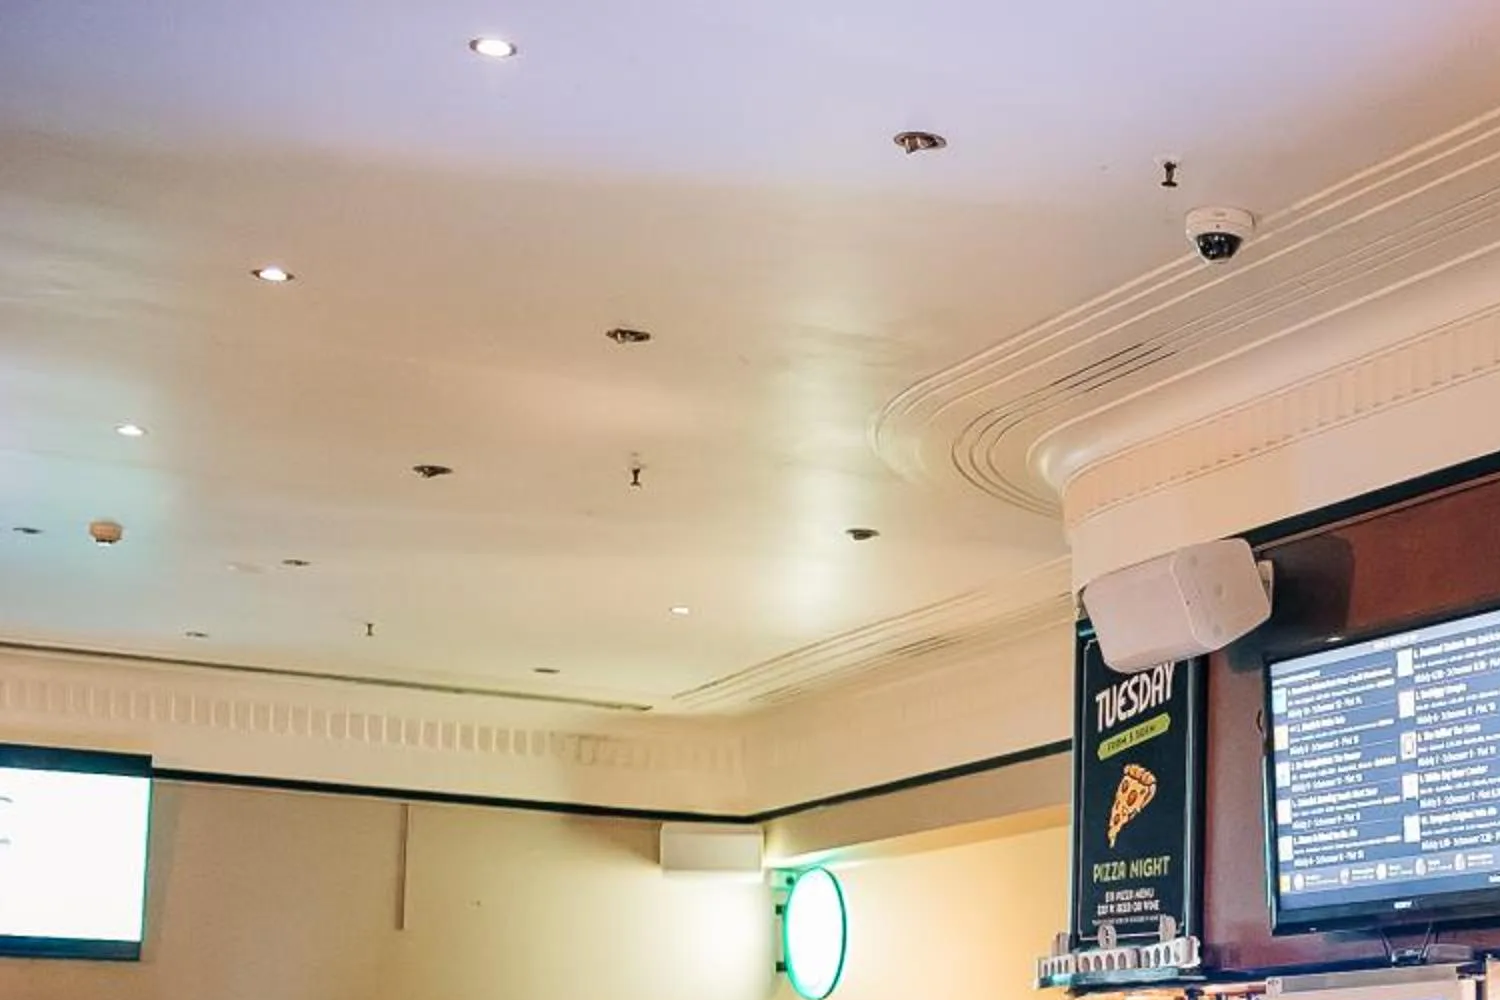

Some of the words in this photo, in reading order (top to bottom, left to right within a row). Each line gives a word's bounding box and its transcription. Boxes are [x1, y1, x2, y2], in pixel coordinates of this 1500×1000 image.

[1095, 661, 1176, 734] TUESDAY
[1093, 861, 1126, 884] PIZZA
[1129, 855, 1171, 879] NIGHT
